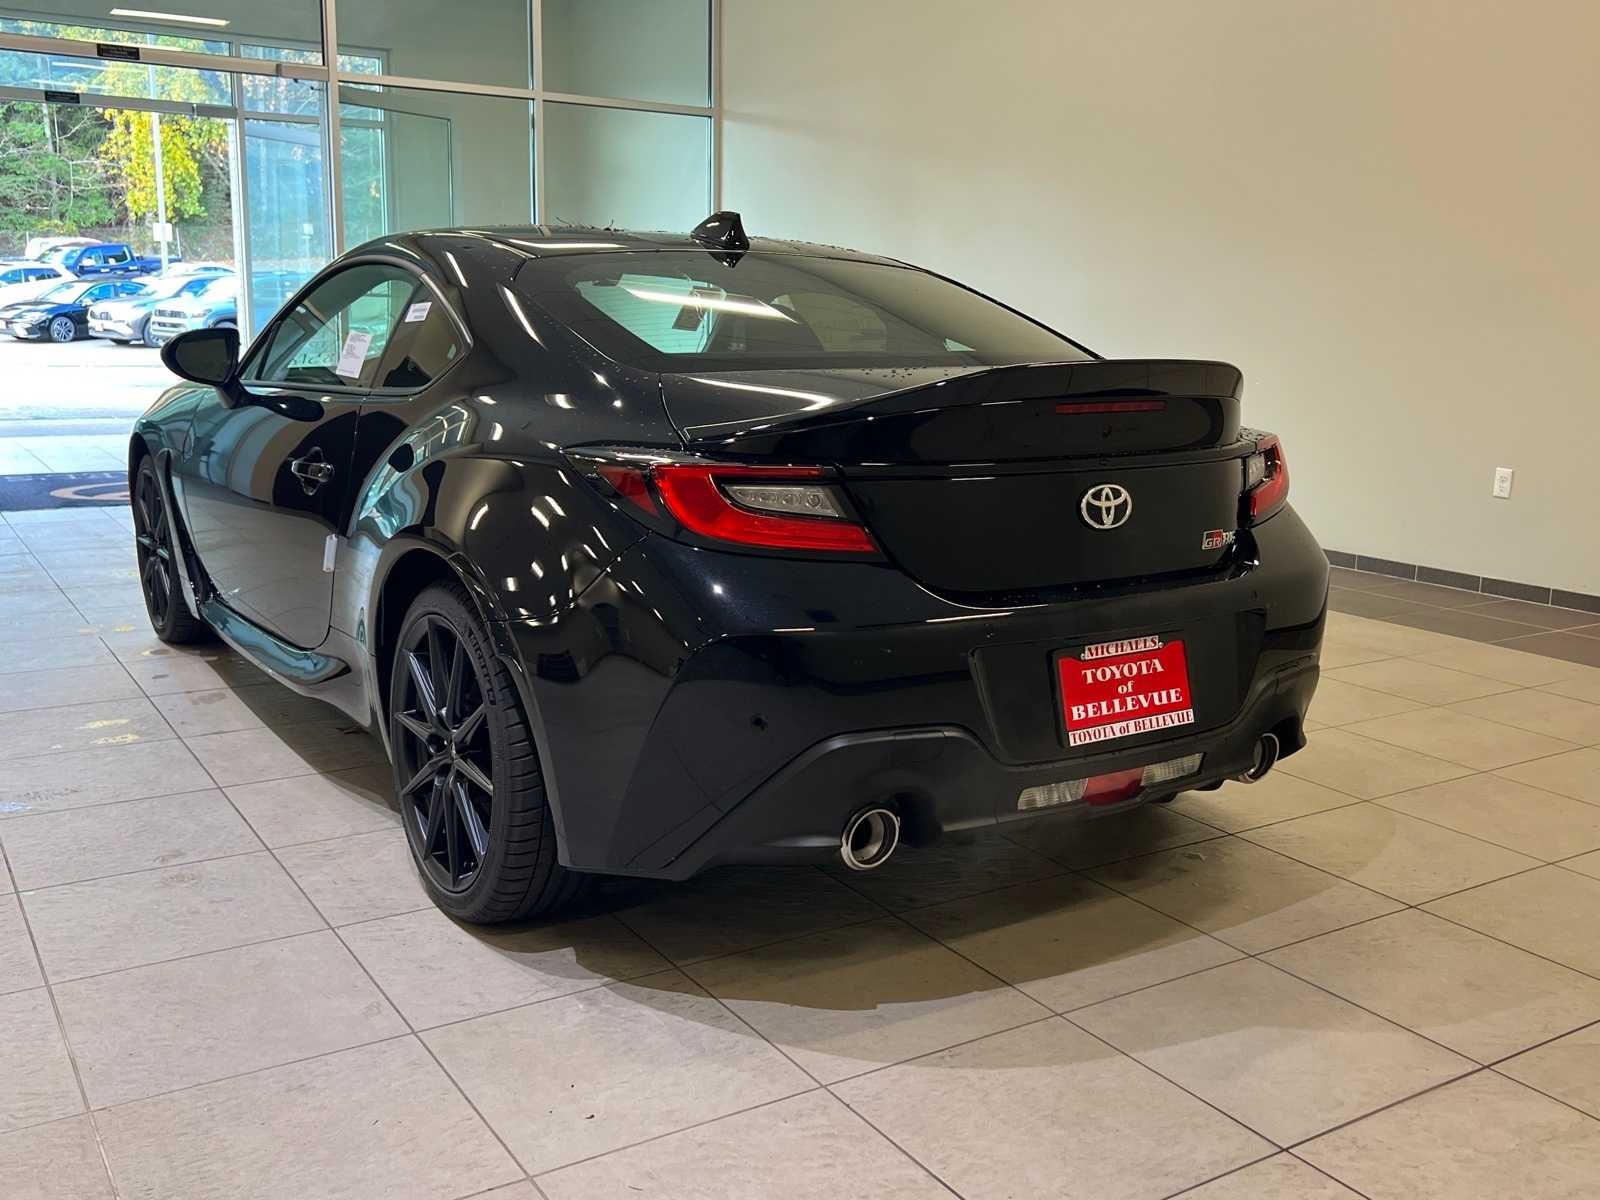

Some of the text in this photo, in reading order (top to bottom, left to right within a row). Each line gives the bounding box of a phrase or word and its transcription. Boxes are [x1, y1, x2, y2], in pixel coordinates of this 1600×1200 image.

[1082, 658, 1165, 684] TOYOTA
[1117, 680, 1135, 695] of
[1071, 688, 1183, 721] BELLEVUE
[1070, 710, 1194, 745] TOYOTA of BELLEVUE
